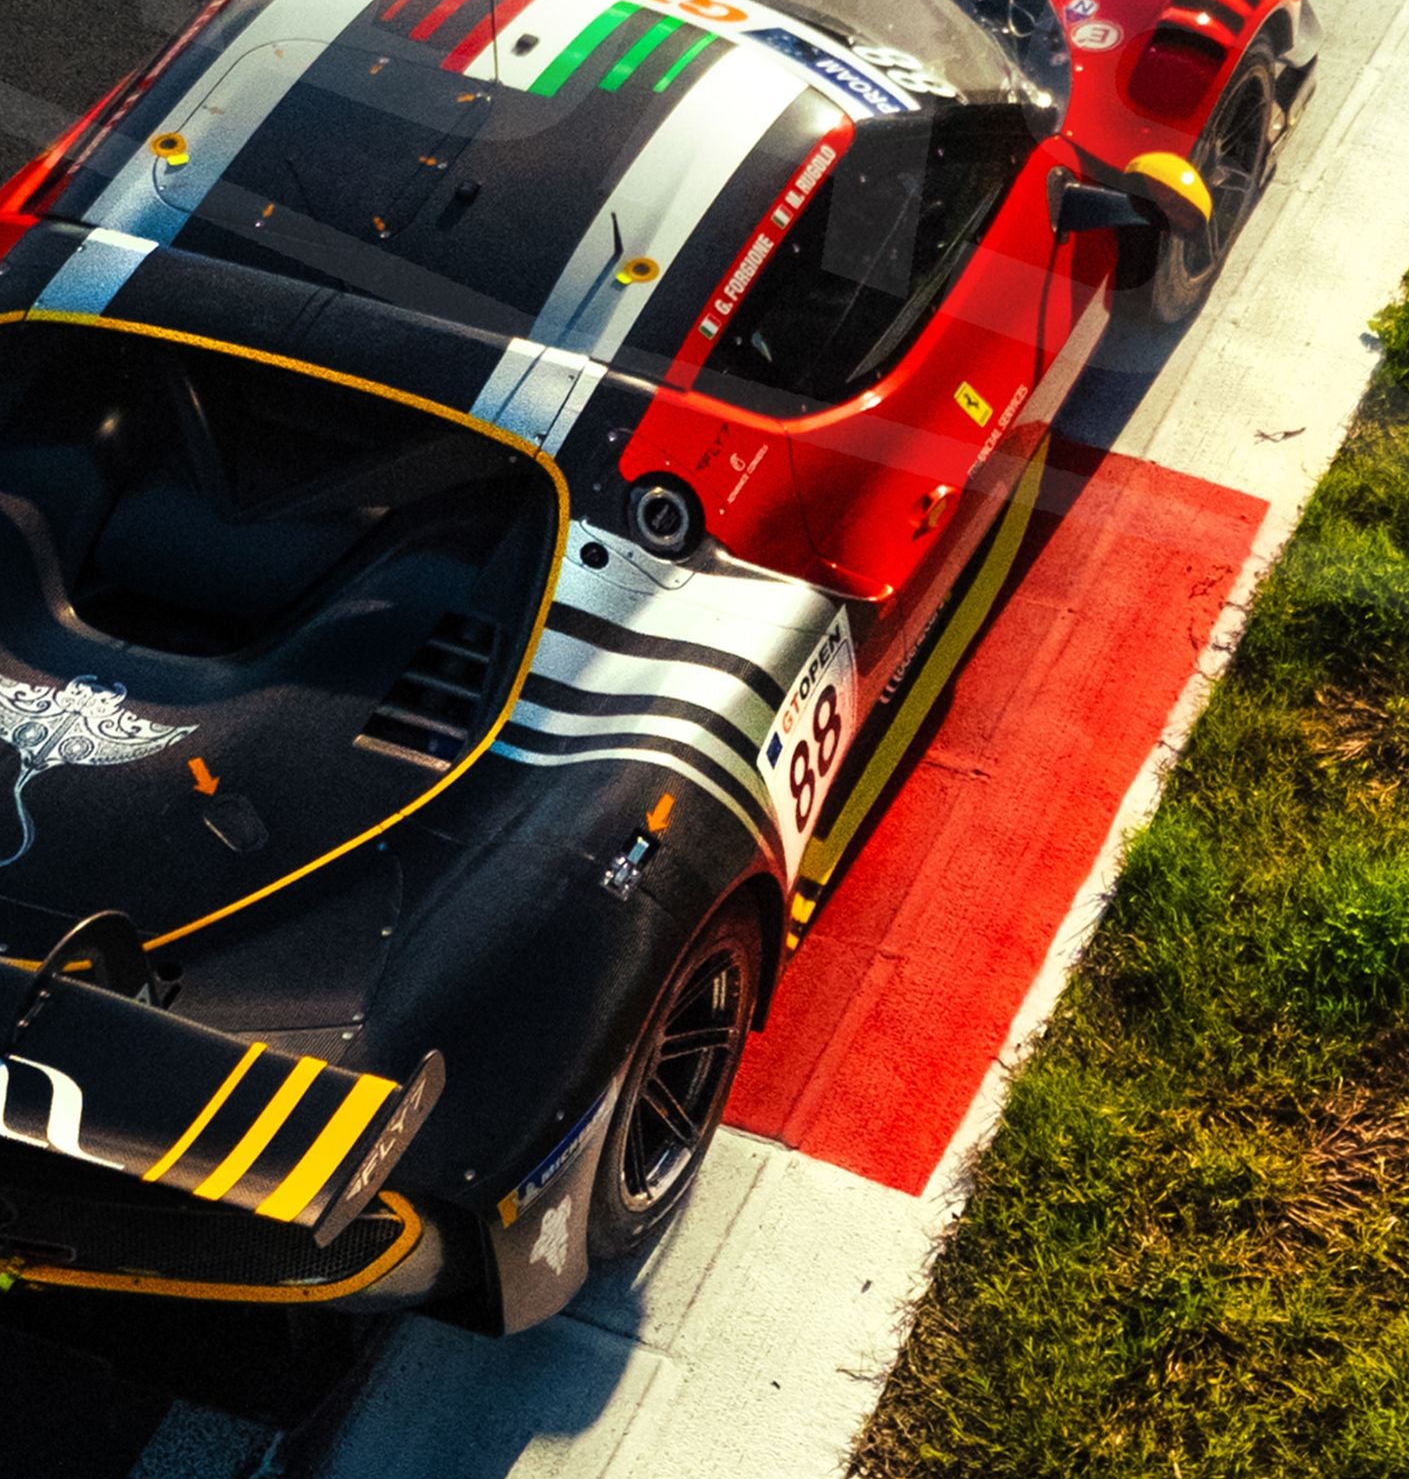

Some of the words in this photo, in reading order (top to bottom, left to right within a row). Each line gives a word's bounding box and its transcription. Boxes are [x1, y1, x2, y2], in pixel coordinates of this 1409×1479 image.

[794, 144, 837, 196] RUGOLO
[723, 232, 776, 303] FORGIONE
[713, 297, 735, 317] G.
[789, 683, 842, 835] 88
